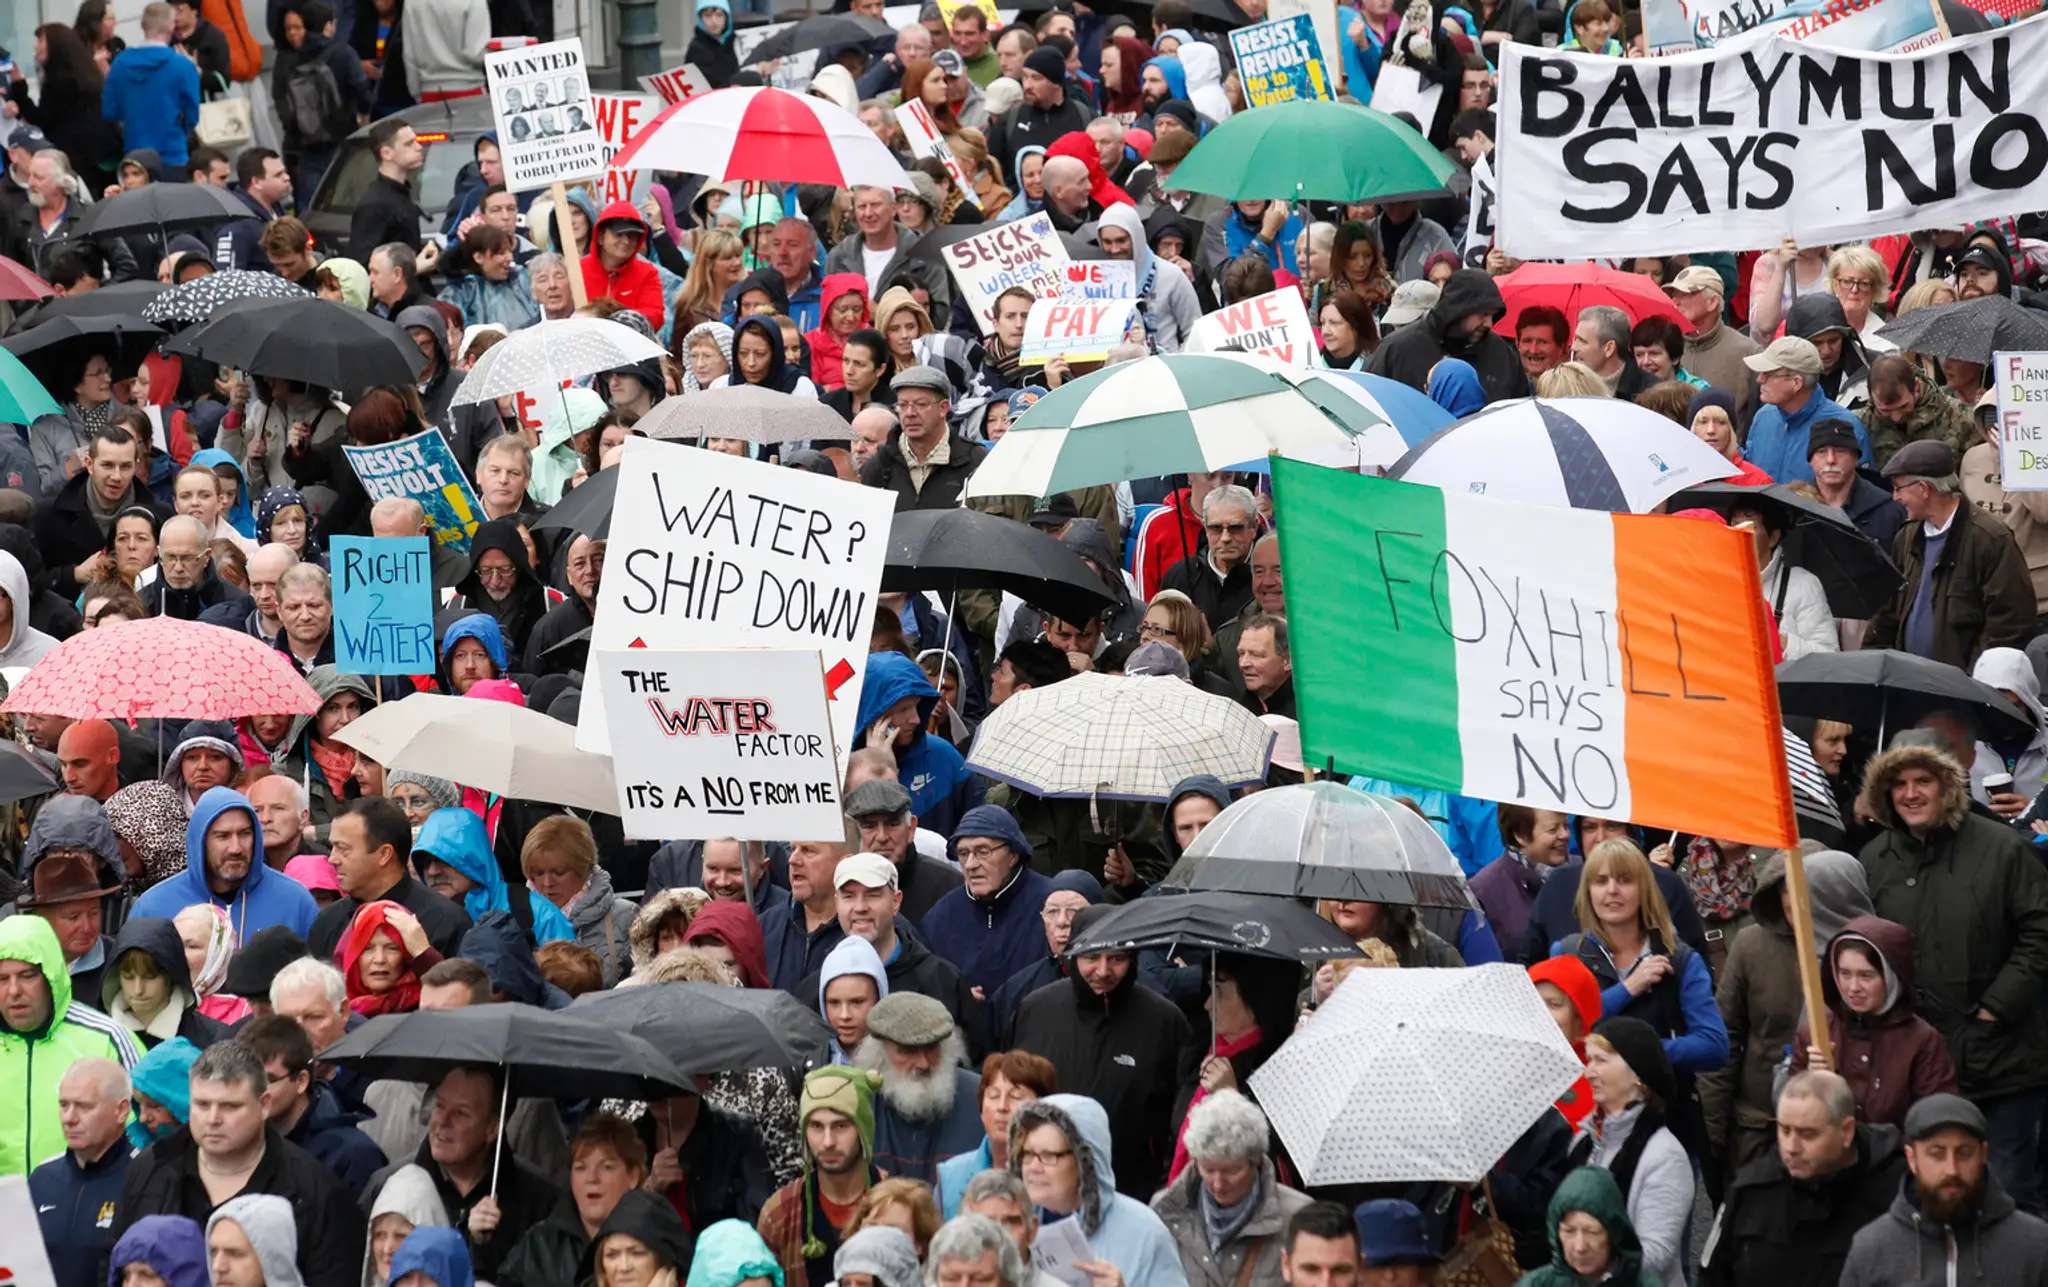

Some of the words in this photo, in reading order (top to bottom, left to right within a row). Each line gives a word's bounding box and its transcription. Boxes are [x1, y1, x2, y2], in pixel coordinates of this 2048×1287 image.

[1235, 19, 1298, 56] RESIST
[493, 51, 578, 79] WANTED
[1241, 40, 1311, 77] REVOLT
[648, 69, 693, 106] WE
[1246, 76, 1269, 93] No
[1272, 71, 1288, 87] to
[1520, 36, 2011, 137] BALLYMUN
[591, 96, 642, 144] WE
[514, 156, 599, 181] CORRUPTION
[1561, 128, 1800, 223] SAYS
[1862, 112, 2048, 212] NO
[1067, 264, 1103, 283] WE
[1044, 306, 1111, 338] PAY
[1215, 294, 1287, 335] WE
[1225, 326, 1289, 350] WON'T
[2003, 410, 2043, 442] FINE
[350, 442, 424, 475] RESIST
[363, 464, 446, 501] REVOLT
[652, 472, 866, 565] WATER?
[343, 548, 428, 594] RIGHT
[367, 593, 392, 620] 2
[752, 570, 866, 642] DOWN
[1375, 530, 1727, 701] FOXHILL
[340, 618, 433, 664] WATER
[621, 670, 671, 693] THE
[648, 698, 777, 736] WATER
[1500, 680, 1603, 731] SAYS
[735, 733, 824, 758] FACTOR
[1513, 733, 1618, 810] NO
[626, 780, 664, 809] IT'S
[674, 785, 696, 808] A
[701, 776, 745, 808] NO
[749, 781, 800, 806] FROM
[805, 782, 836, 804] ME
